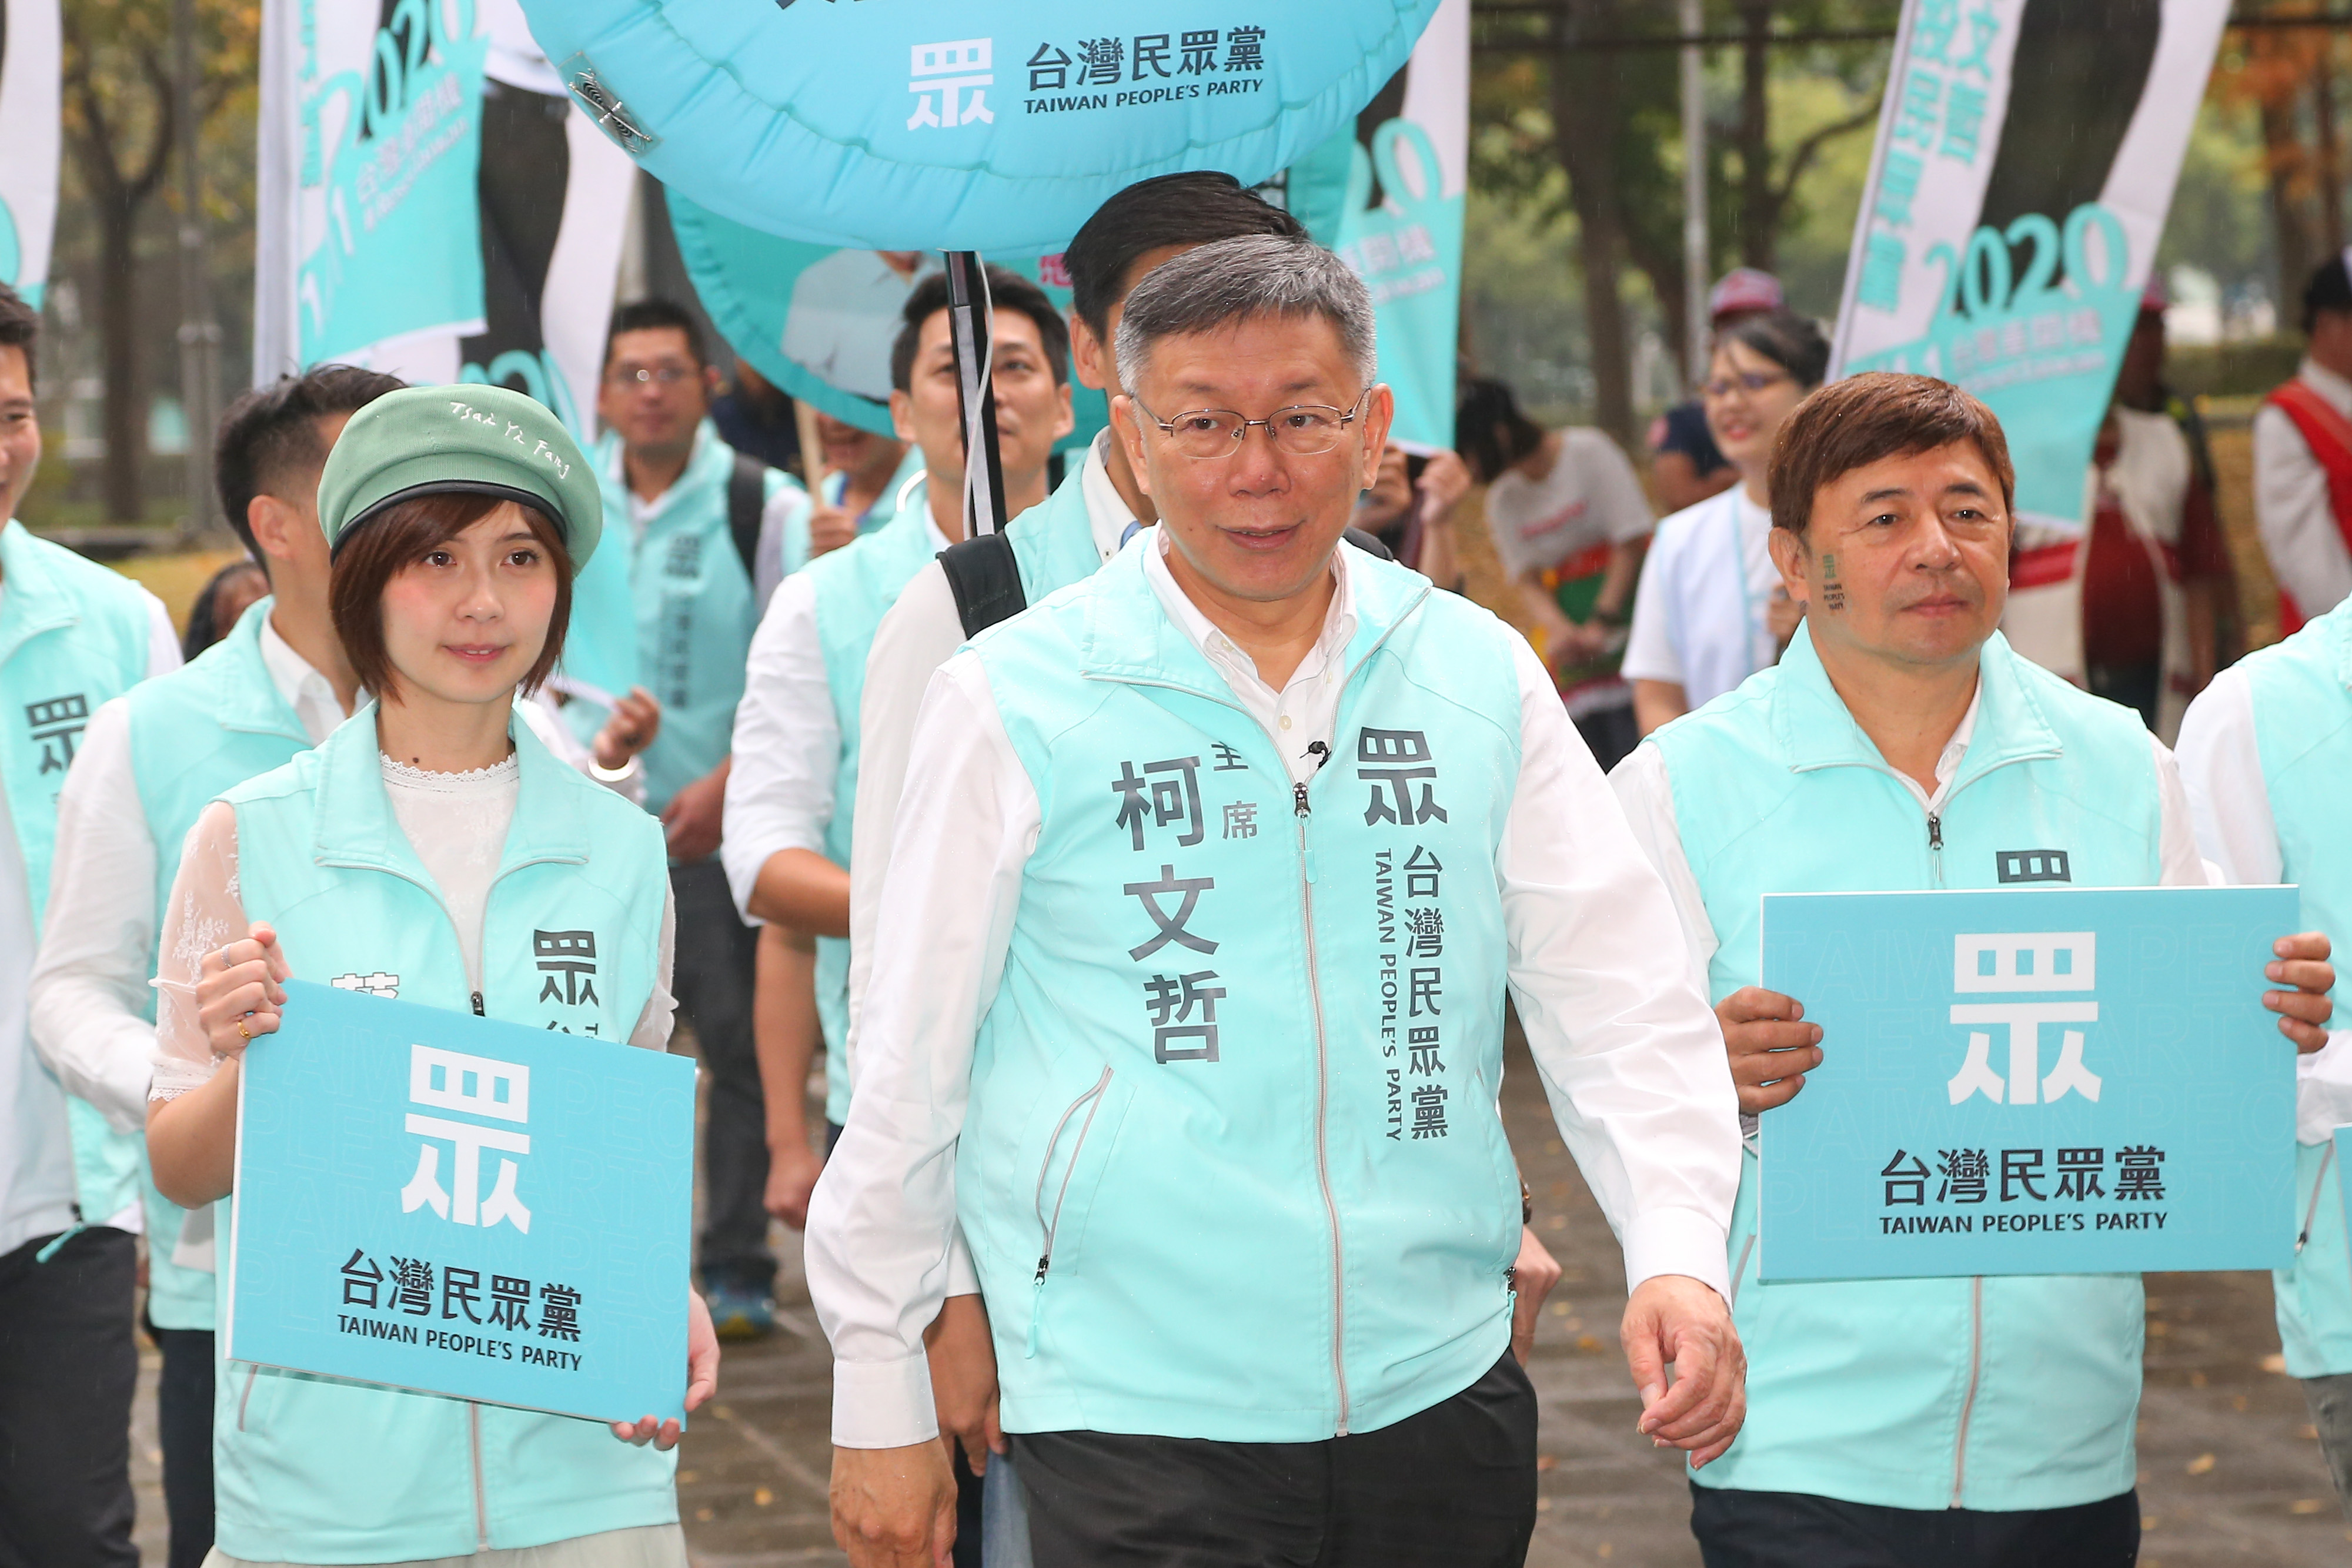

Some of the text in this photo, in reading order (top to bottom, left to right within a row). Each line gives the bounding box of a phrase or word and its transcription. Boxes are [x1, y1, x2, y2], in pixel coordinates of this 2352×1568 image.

[907, 37, 995, 131] 眾
[1024, 79, 1263, 114] TAIWAN PEOPLE'S PARTY
[1026, 25, 1265, 92] 台灣民眾黨
[1923, 202, 2127, 322] 2020
[450, 402, 571, 479] Tsai Yi Fang
[1211, 741, 1258, 840] 主席
[1357, 727, 1448, 827] 眾
[1111, 755, 1227, 1065] 柯文哲
[533, 929, 599, 1007] 眾
[1375, 848, 1402, 1141] TAIWAN PEOPLE'S PARTY
[1404, 845, 1448, 1141] 台灣民眾黨
[1947, 931, 2102, 1105] 眾
[401, 1044, 532, 1235] 眾
[1880, 1145, 2166, 1206] 台灣民眾黨
[1879, 1211, 2167, 1234] TAIWAN PEOPLE'S PARTY
[339, 1248, 582, 1343] 台灣民眾黨
[338, 1315, 582, 1372] TAIWAN PEOPLE'S PARTY
